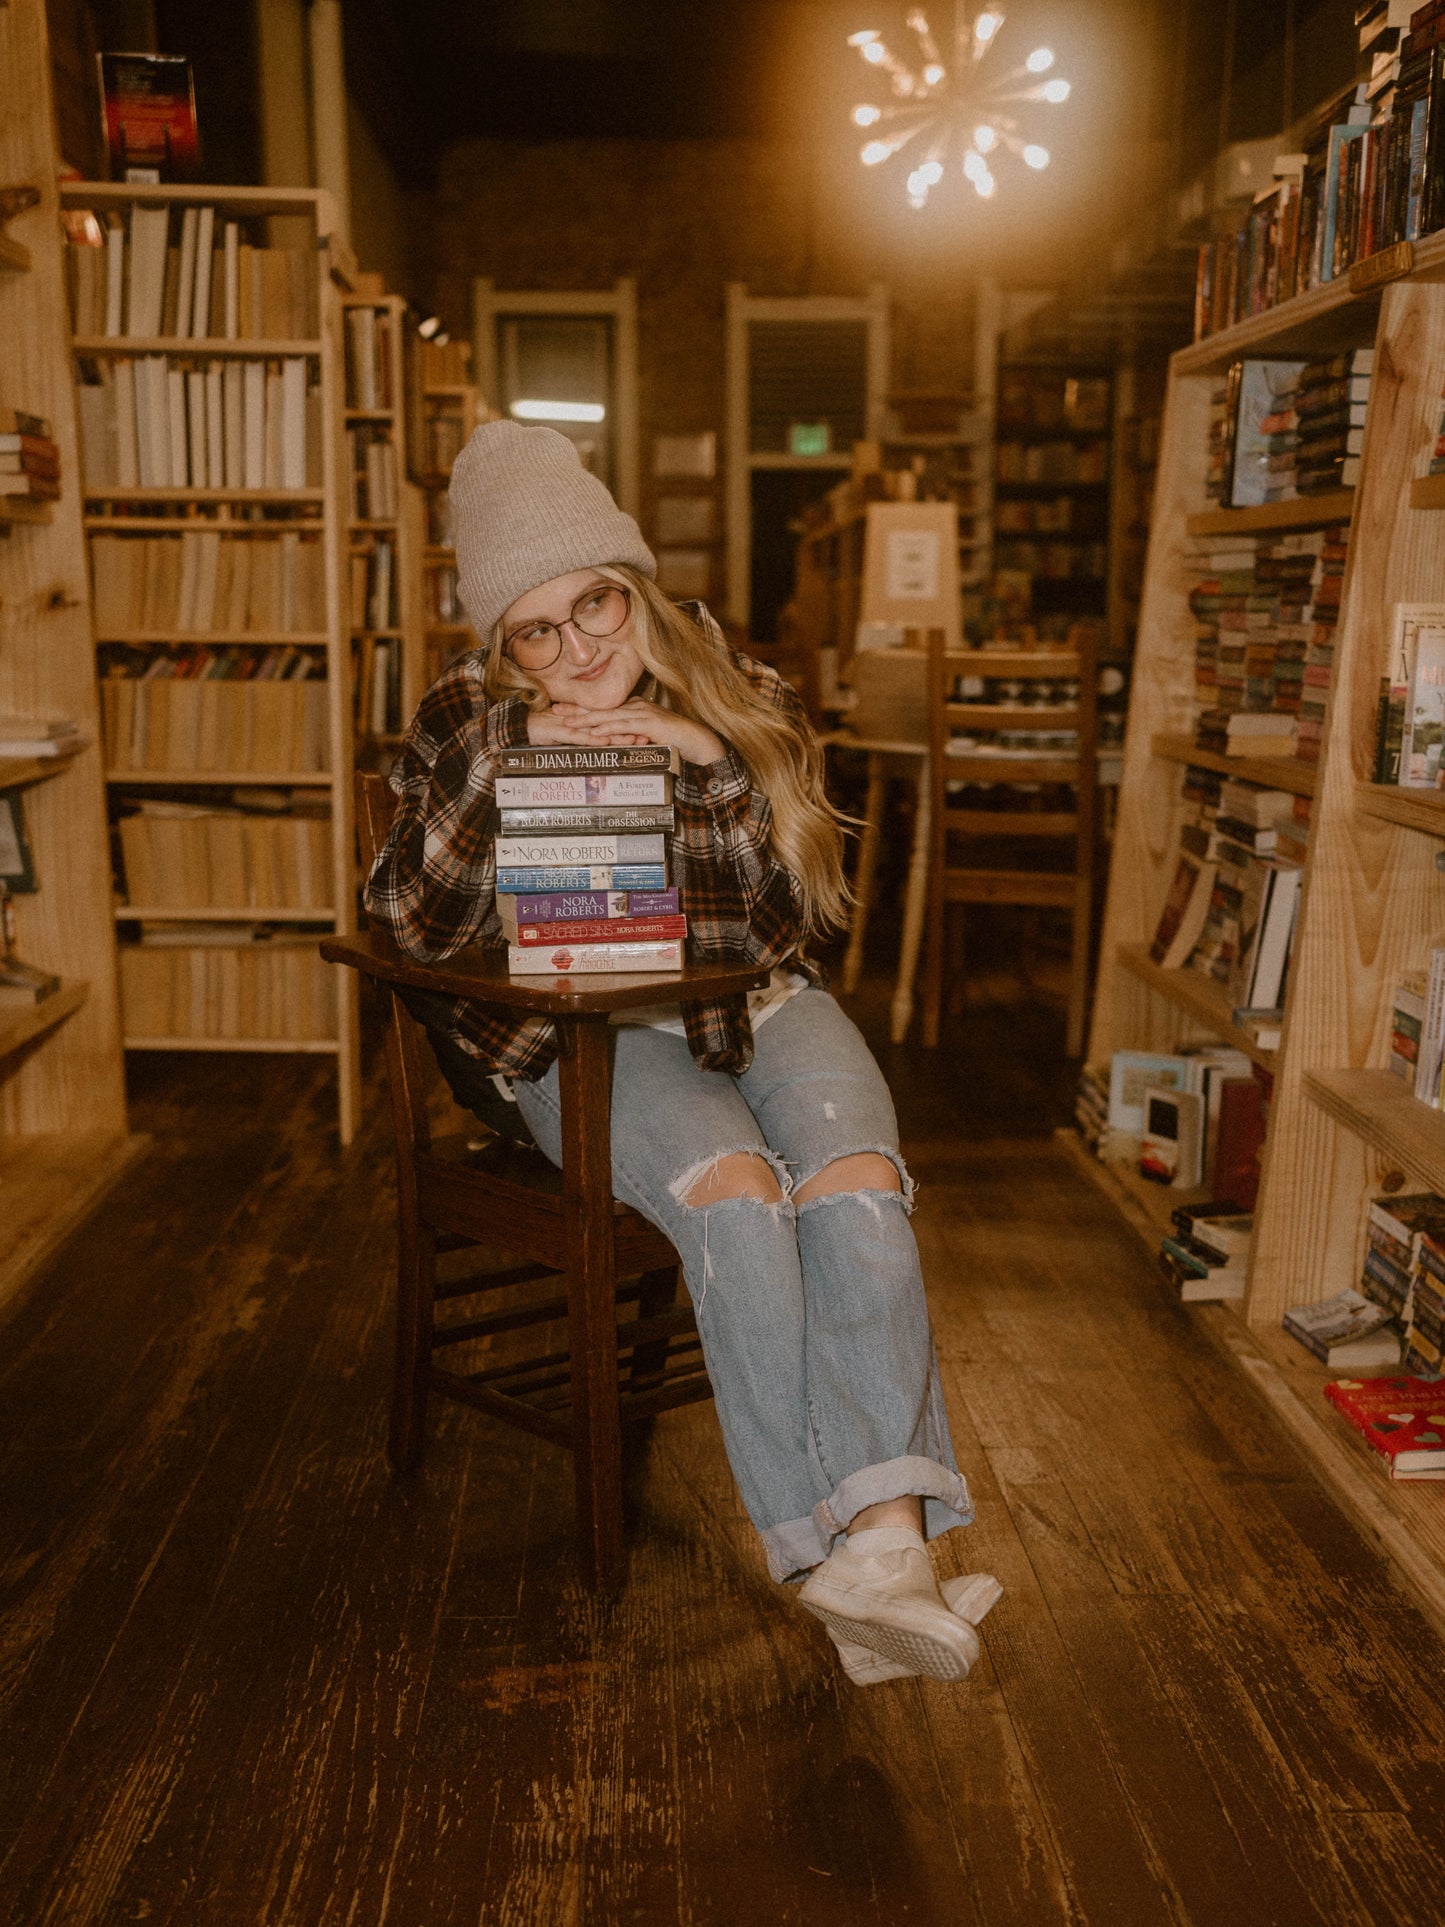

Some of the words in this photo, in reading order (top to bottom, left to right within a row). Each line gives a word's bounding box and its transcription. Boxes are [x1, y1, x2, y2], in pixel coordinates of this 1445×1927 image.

[535, 753, 573, 769] DIANA
[575, 752, 620, 769] PALMER
[623, 755, 665, 764] LEGEND
[540, 781, 575, 791] NORA
[532, 791, 583, 801] ROBERTS
[521, 815, 548, 827] NORA
[551, 814, 592, 826] ROBERTS
[607, 817, 656, 827] OBSESSION
[517, 846, 559, 862] NORA
[562, 845, 615, 861] ROBERTS
[620, 847, 658, 857] RETURN
[535, 878, 587, 888] ROBERTS
[562, 895, 597, 907] NORA
[555, 904, 605, 917] ROBERTS
[543, 925, 588, 940] SACRED
[590, 924, 614, 938] SINS
[616, 926, 635, 934] NORA
[635, 924, 664, 933] ROBERTS
